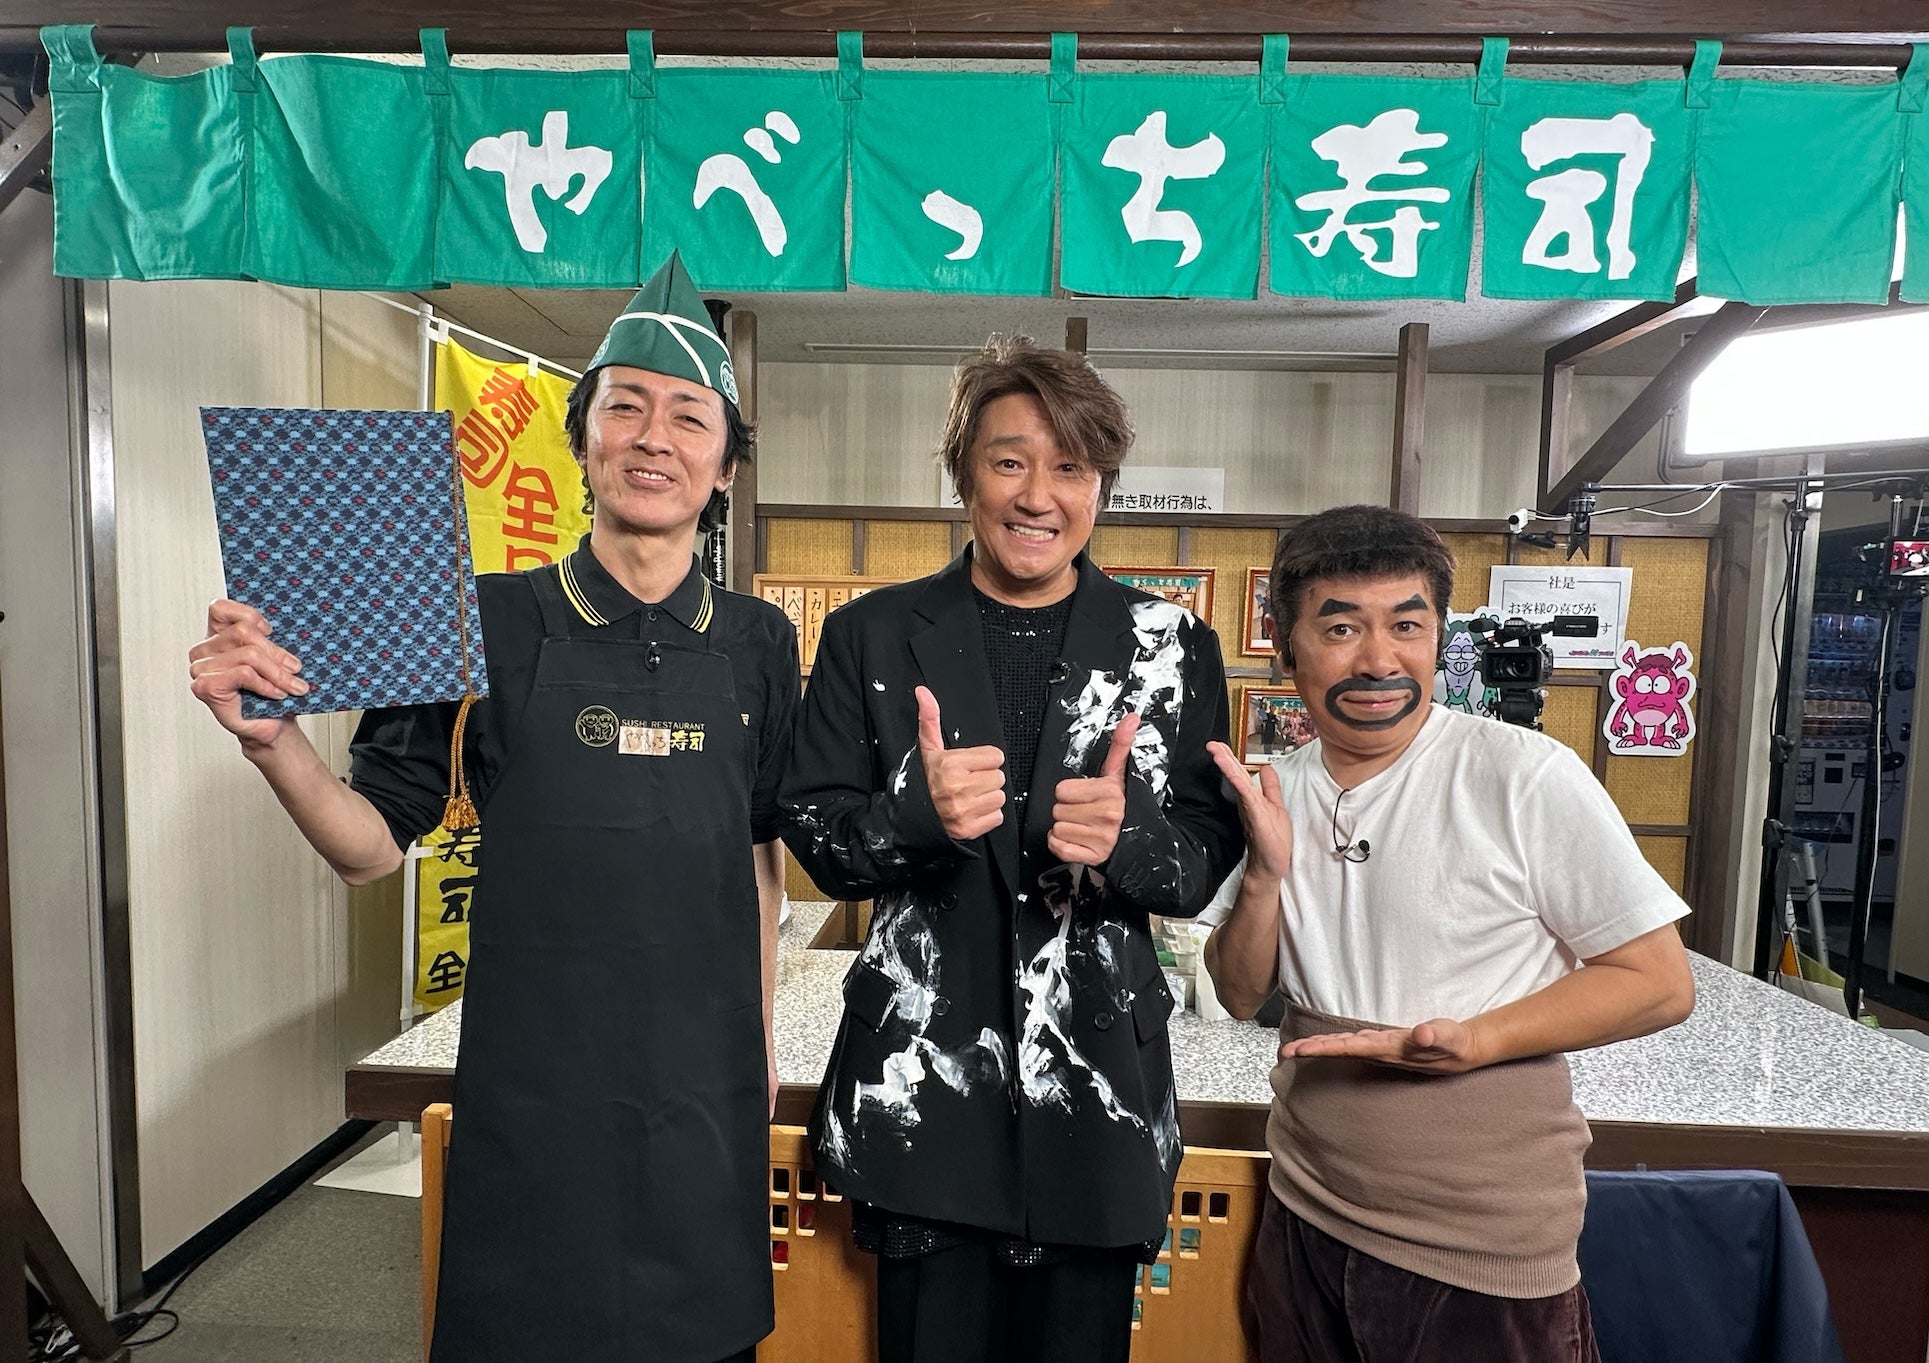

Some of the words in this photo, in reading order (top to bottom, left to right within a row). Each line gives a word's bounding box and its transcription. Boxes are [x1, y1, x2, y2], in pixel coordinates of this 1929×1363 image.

[464, 108, 1655, 281] やべっち寿司
[1549, 576, 1576, 590] 社是
[1508, 602, 1597, 615] お客様の喜びが
[811, 598, 822, 639] カレー
[621, 719, 647, 728] SUSHI
[650, 720, 706, 731] RESTAURANT
[669, 730, 706, 752] 寿司
